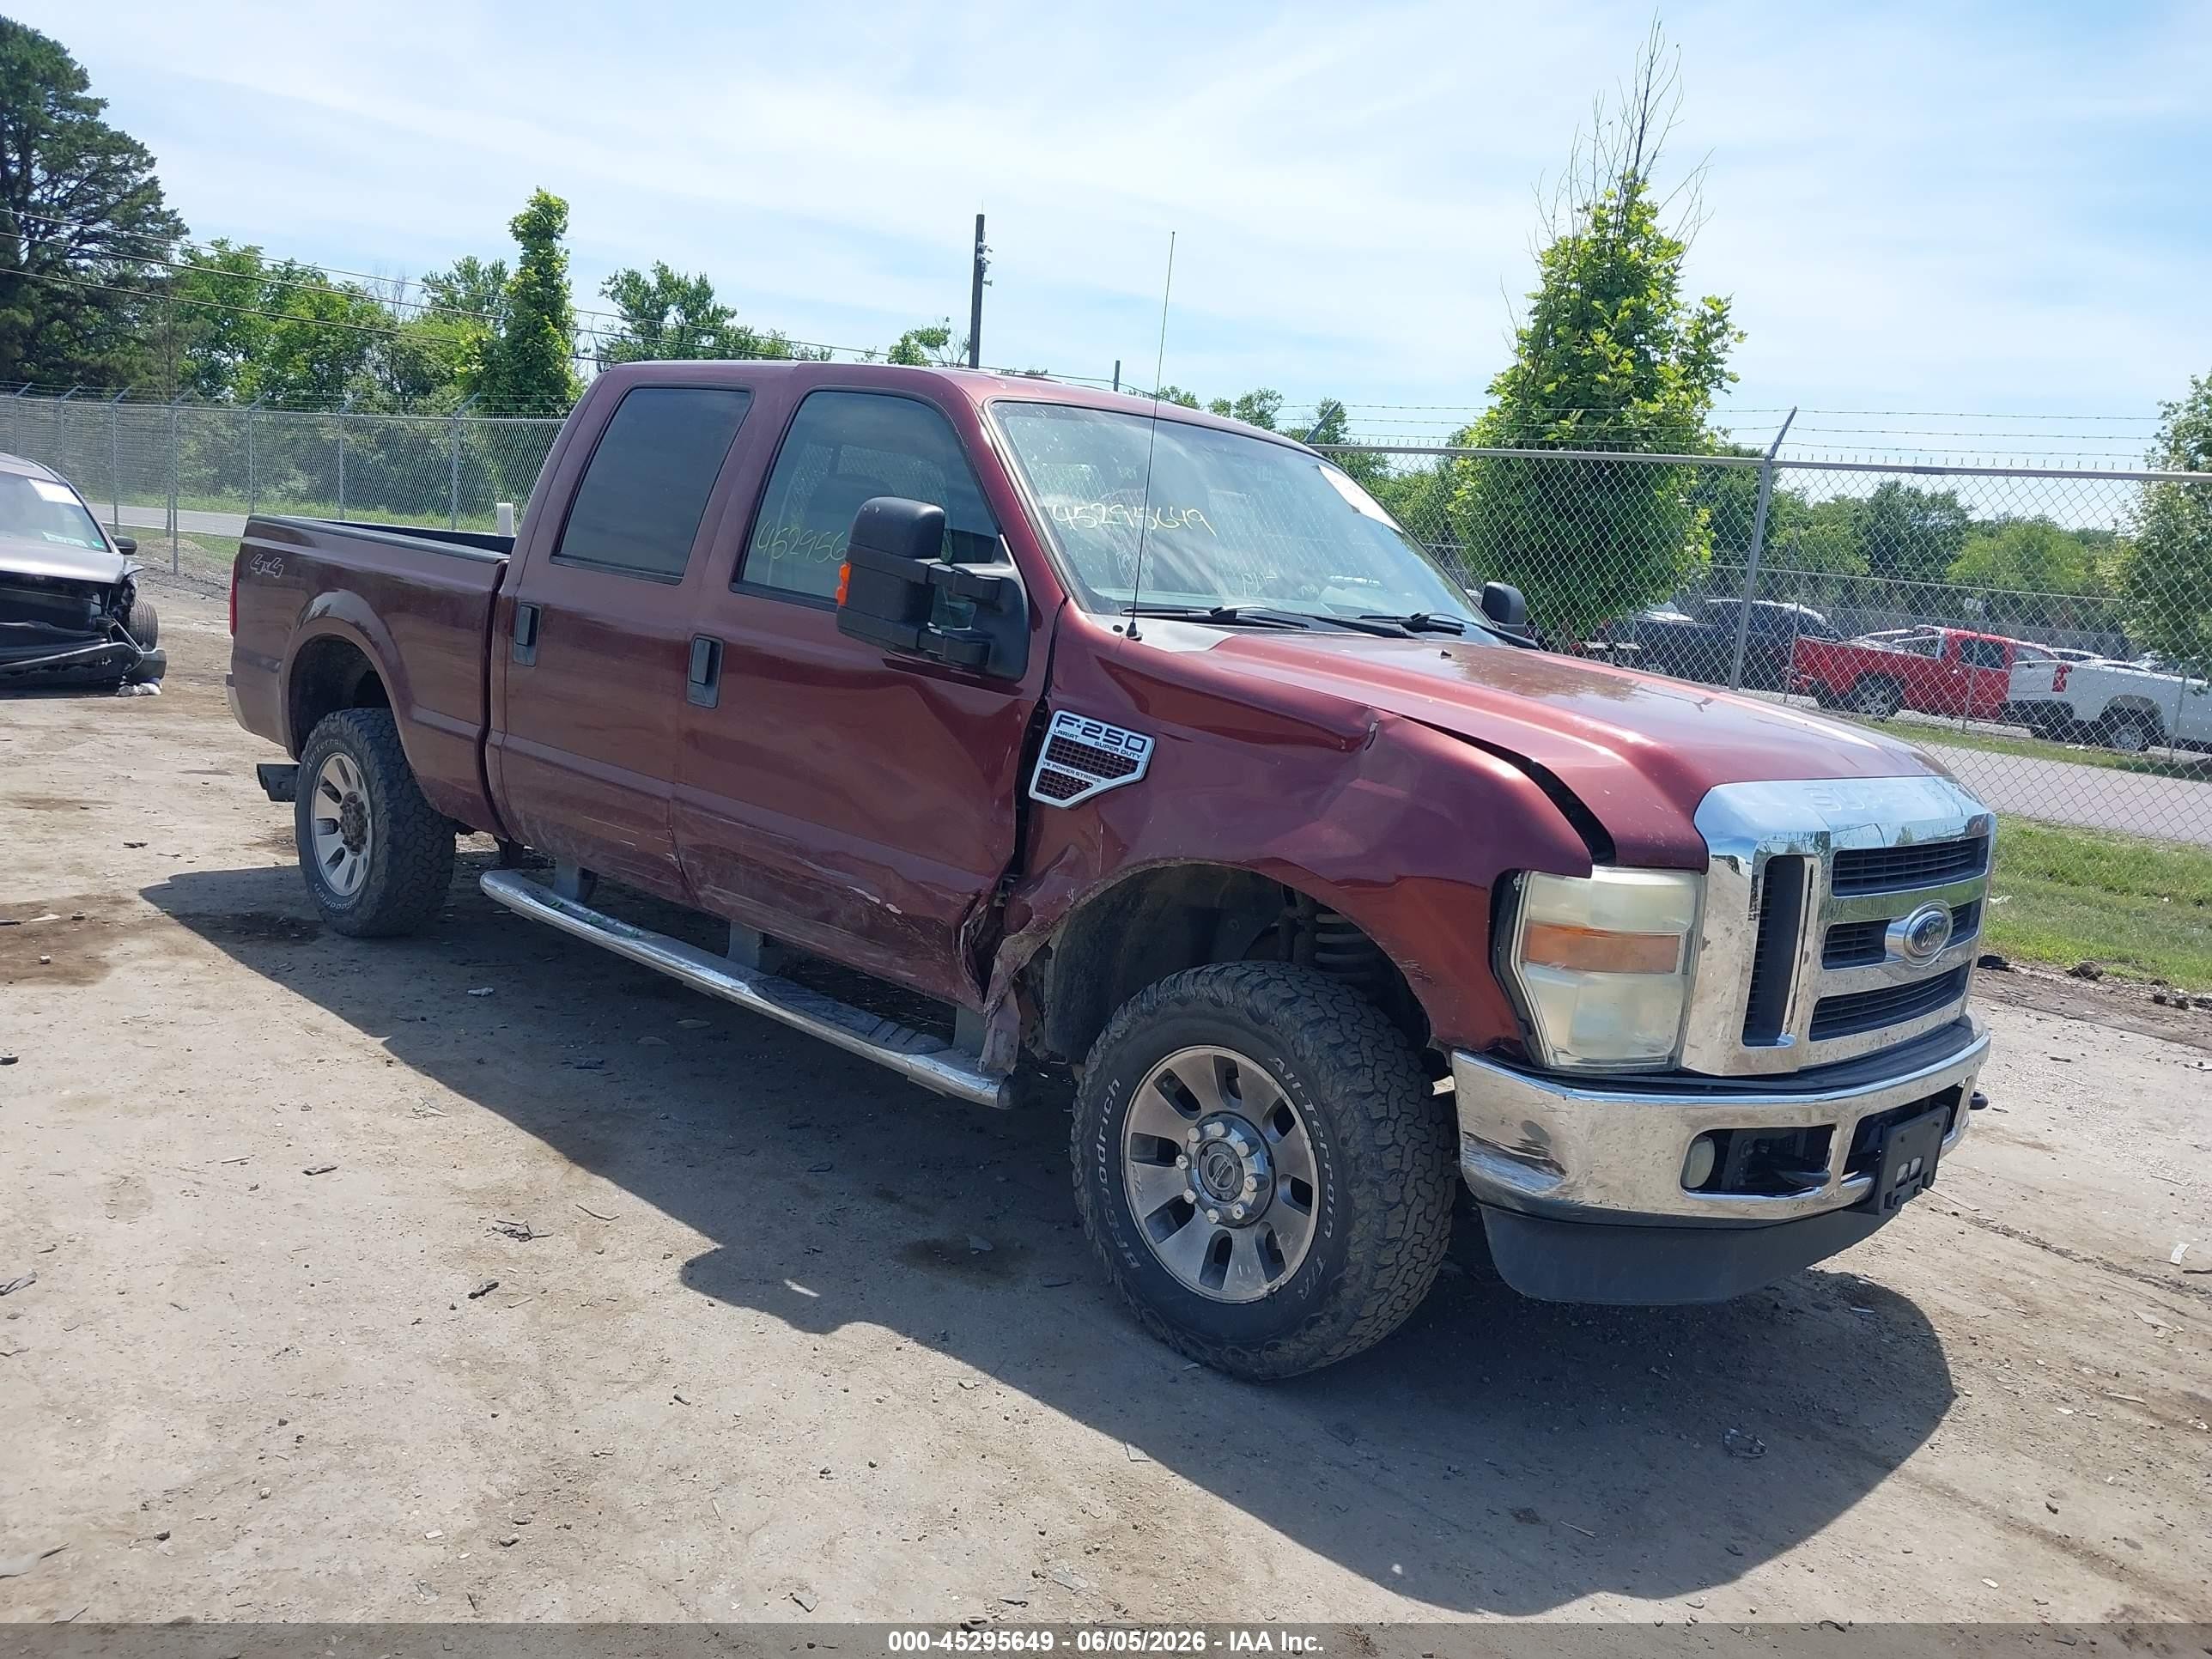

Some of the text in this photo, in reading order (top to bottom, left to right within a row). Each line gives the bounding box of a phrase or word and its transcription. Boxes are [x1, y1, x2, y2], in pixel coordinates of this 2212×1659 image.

[1052, 501, 1218, 538] 45295649
[249, 553, 284, 578] 4x4
[1053, 728, 1079, 740] LARIAT
[1055, 714, 1147, 753] F-250
[1094, 741, 1143, 760] SUPER DUTY
[1051, 763, 1075, 775] POWER
[1075, 770, 1102, 784] STROKE
[1921, 921, 1946, 947] Ford
[1267, 1057, 1336, 1239] All-Terrain
